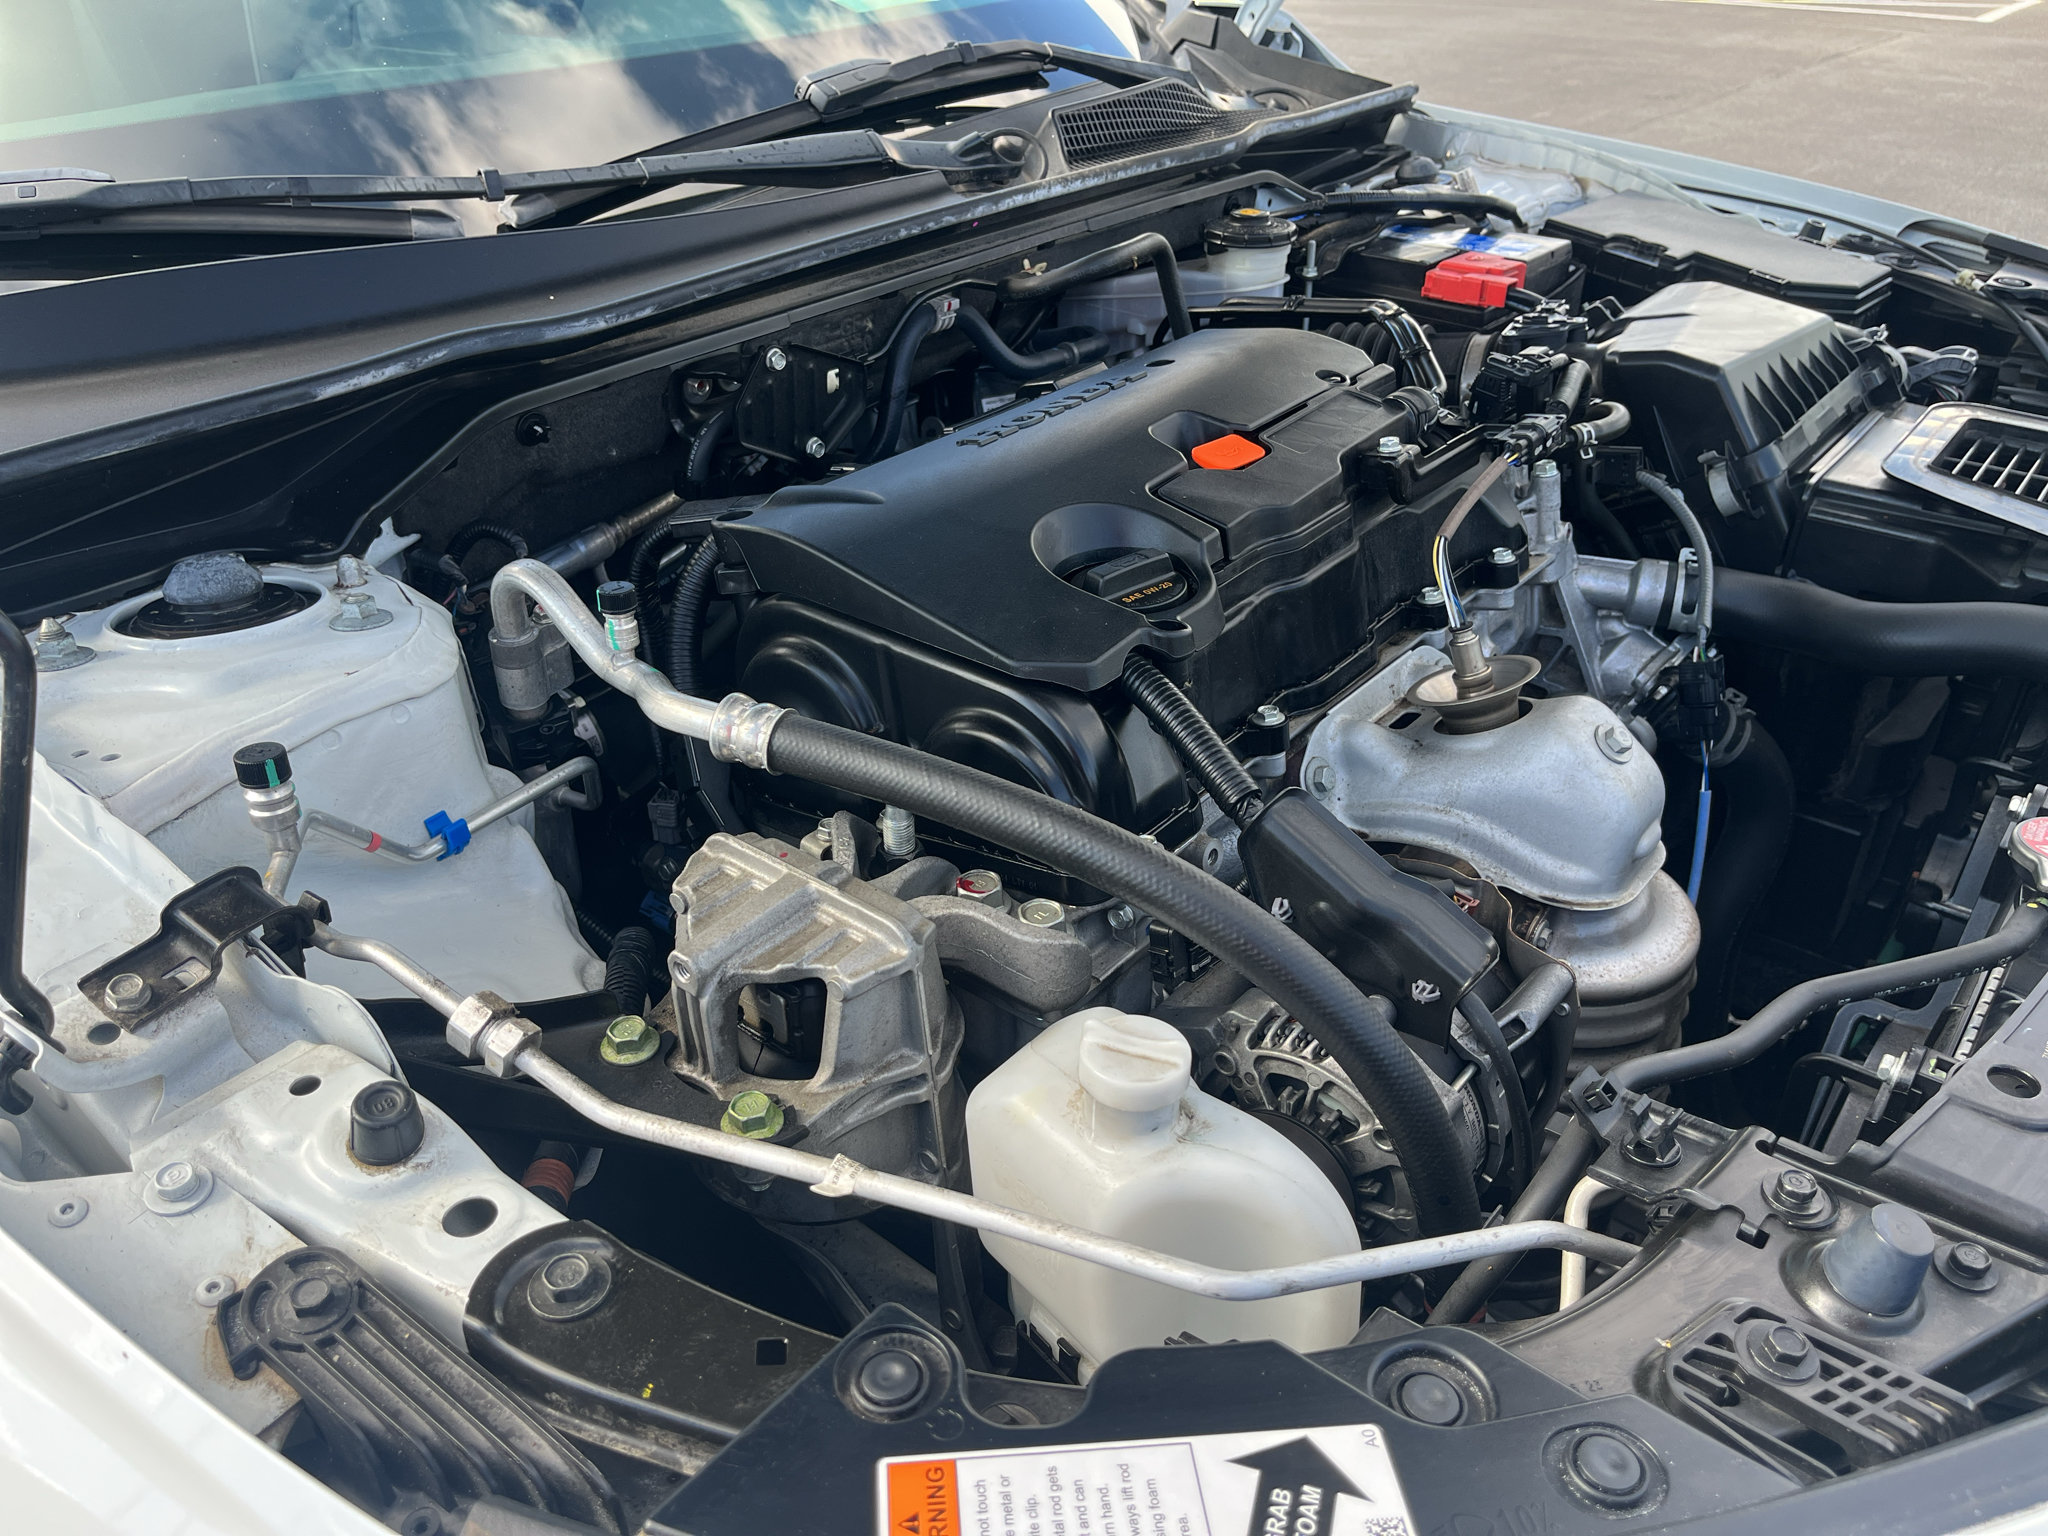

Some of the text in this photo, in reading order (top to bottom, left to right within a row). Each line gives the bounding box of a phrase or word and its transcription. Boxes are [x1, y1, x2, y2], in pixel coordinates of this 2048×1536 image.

[1121, 592, 1145, 603] SAE
[1143, 581, 1173, 595] 0W-20
[1000, 1474, 1011, 1487] or
[1046, 1465, 1063, 1492] gets
[1074, 1479, 1086, 1502] can
[926, 1466, 948, 1536] RNING
[974, 1479, 988, 1515] touch
[999, 1491, 1015, 1526] metal
[1025, 1494, 1040, 1519] clip.
[1048, 1495, 1063, 1516] rod
[1097, 1484, 1113, 1519] hand.
[1117, 1463, 1142, 1536] ways lift rod
[1146, 1478, 1166, 1536] sing foam
[1075, 1505, 1090, 1529] and
[1179, 1512, 1192, 1536] rea.
[1263, 1487, 1292, 1536] RAB
